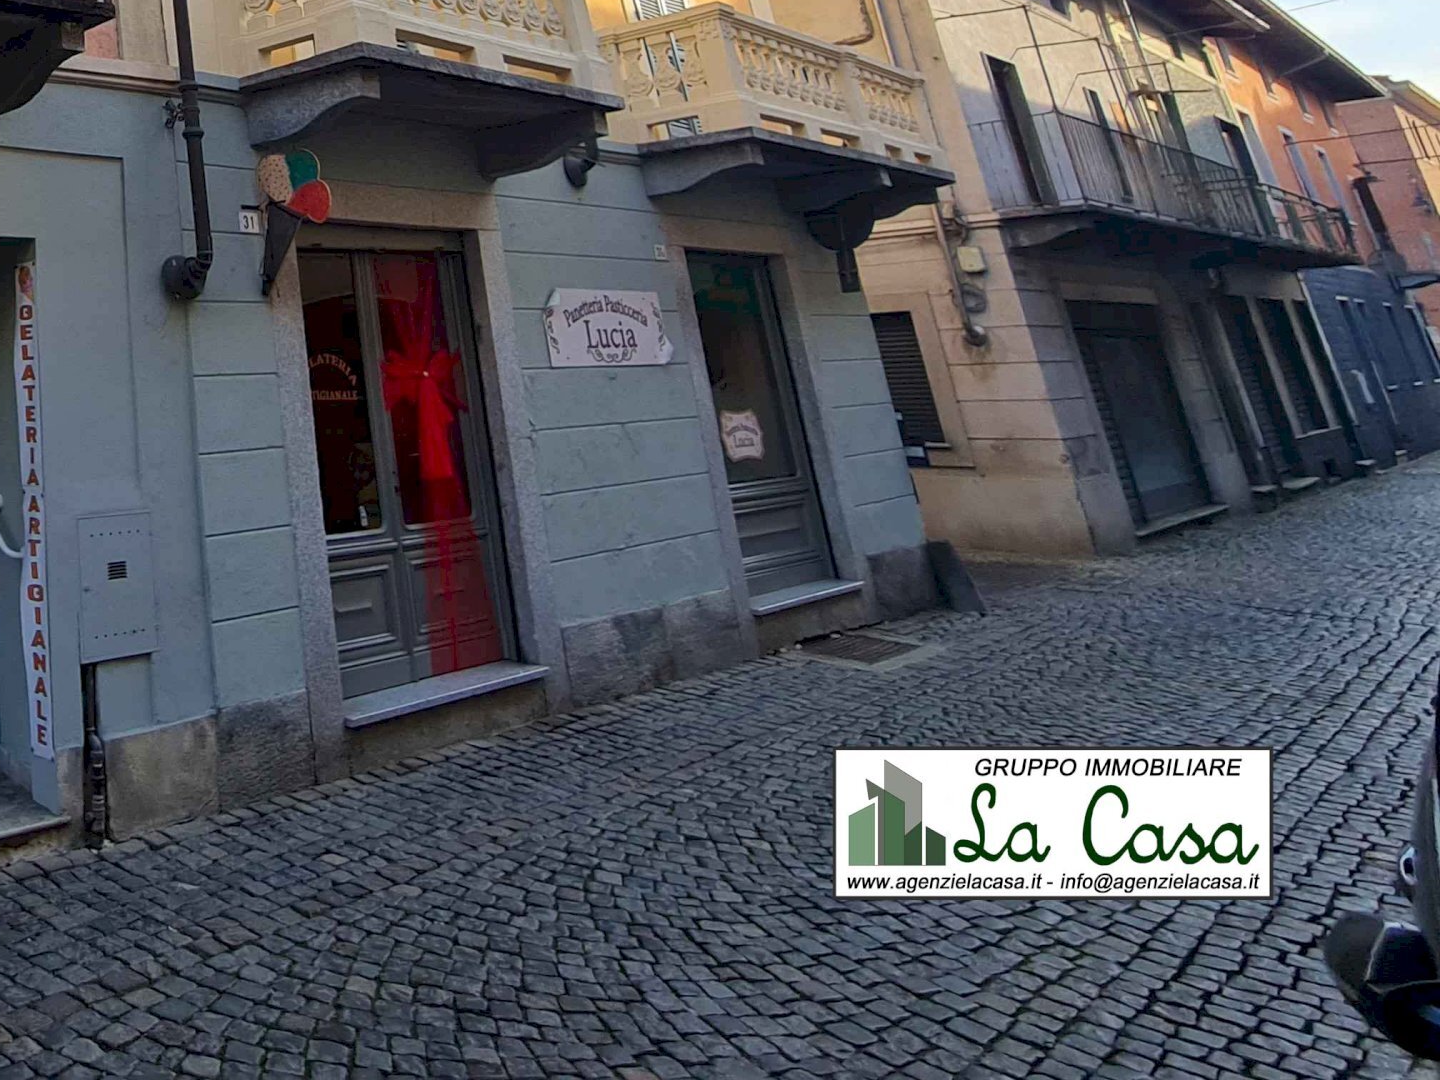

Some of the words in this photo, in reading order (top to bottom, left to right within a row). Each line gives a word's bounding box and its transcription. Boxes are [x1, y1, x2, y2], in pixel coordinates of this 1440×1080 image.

[243, 215, 255, 229] 31
[563, 296, 604, 328] Panetteria
[603, 295, 648, 327] Pasticceria
[583, 320, 638, 349] Lucia
[308, 353, 357, 386] LATERIA
[19, 304, 40, 486] GELATERIA
[312, 390, 358, 400] TIGIANALE
[27, 495, 48, 746] ARTIGIANALE
